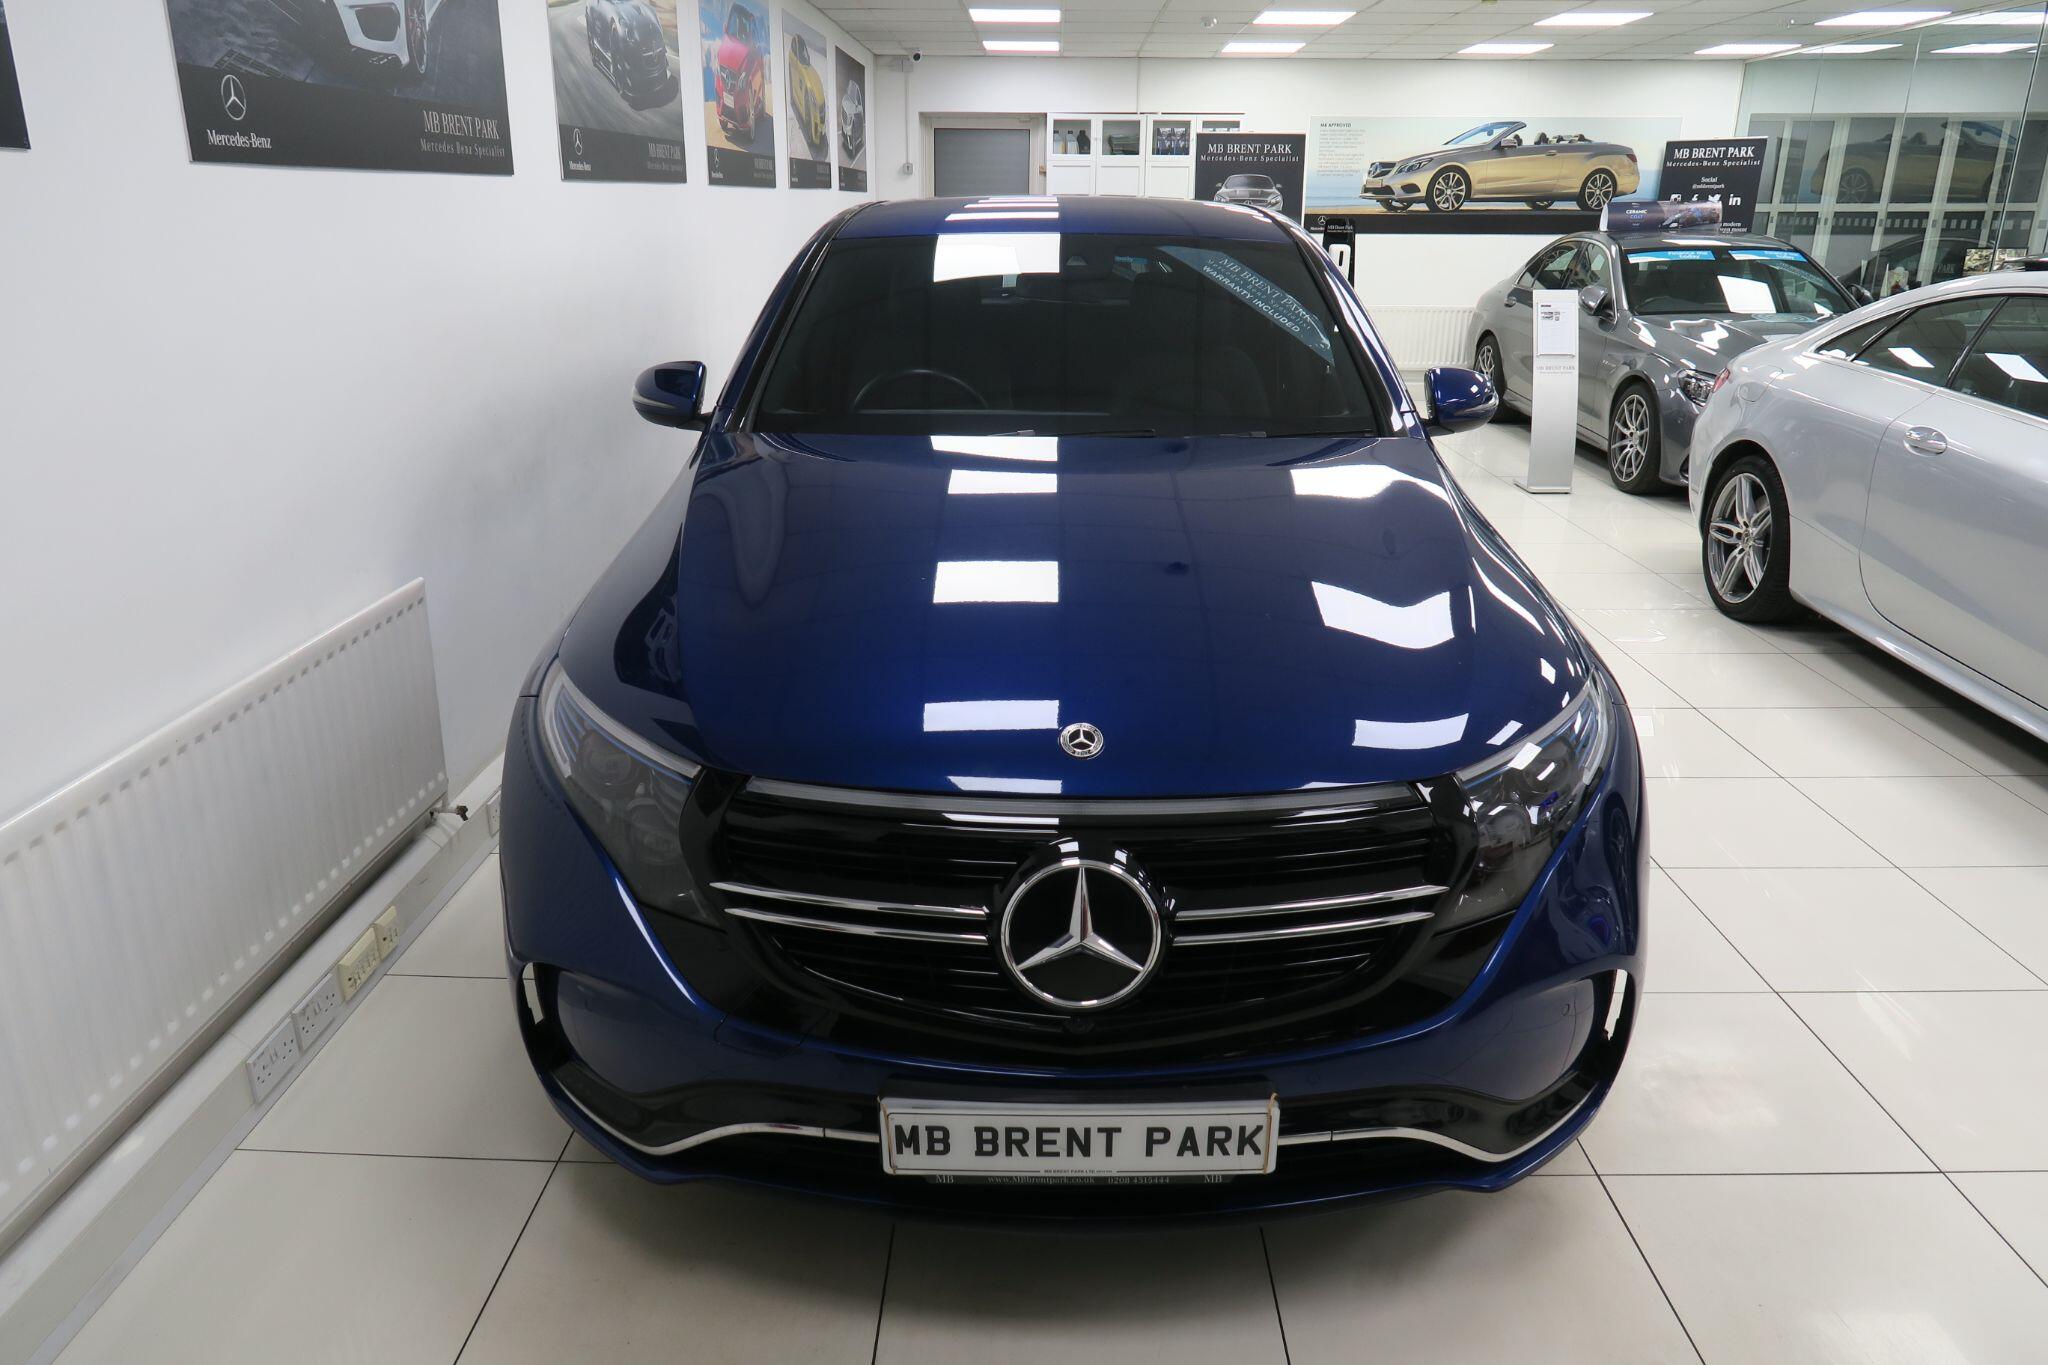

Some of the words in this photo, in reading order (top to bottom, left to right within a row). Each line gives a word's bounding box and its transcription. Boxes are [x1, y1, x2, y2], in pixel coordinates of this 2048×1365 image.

[423, 110, 440, 133] MB
[441, 112, 473, 137] BRENT
[475, 117, 500, 140] PARK
[206, 128, 272, 149] Mercedes-Benz
[420, 138, 455, 154] Mercedes
[474, 144, 506, 158] Specialist
[1207, 143, 1224, 154] MB
[1226, 143, 1261, 154] BRENT
[1263, 143, 1292, 154] PARK
[1260, 155, 1299, 163] Specialist
[1673, 148, 1690, 159] MB
[1691, 147, 1726, 159] BRENT
[1727, 146, 1755, 158] PARK
[1666, 160, 1720, 168] Mercedes-Benz
[1723, 159, 1760, 168] Specialist
[1203, 265, 1253, 299] WARRANTY
[1253, 298, 1300, 333] INCLUDED
[1219, 258, 1241, 273] MB
[1240, 270, 1281, 299] BRENT
[1281, 297, 1312, 323] PARK
[895, 1125, 951, 1156] MB
[974, 1126, 1122, 1158] BRENT
[1145, 1125, 1264, 1157] PARK
[936, 1174, 954, 1183] MB
[1204, 1173, 1222, 1184] MB
